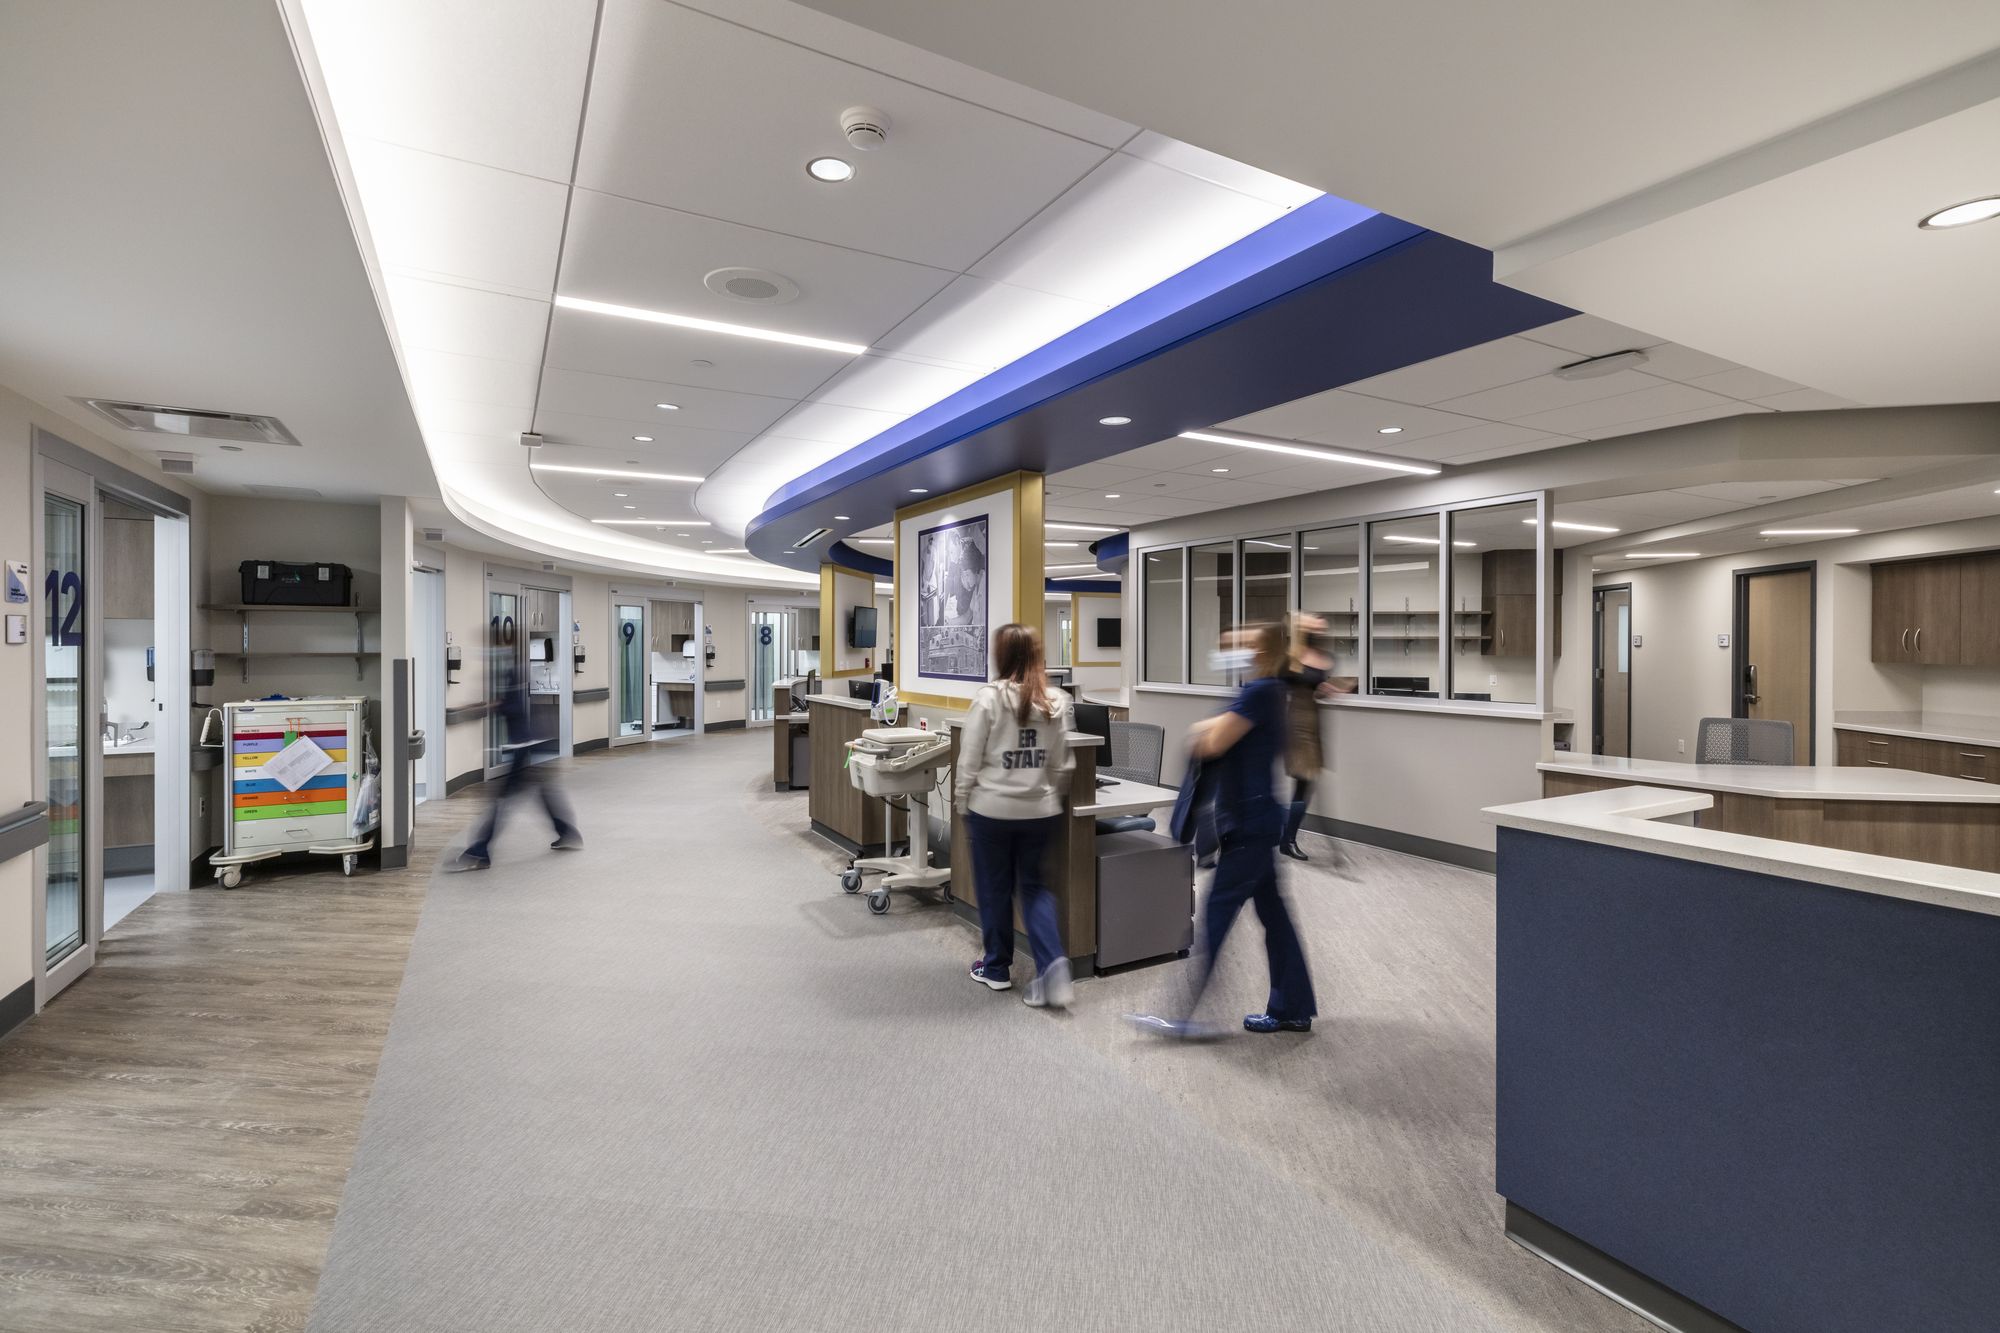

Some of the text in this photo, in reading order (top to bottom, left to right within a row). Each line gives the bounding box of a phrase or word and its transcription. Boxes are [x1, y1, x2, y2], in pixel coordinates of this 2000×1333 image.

[45, 570, 81, 646] 12
[491, 615, 514, 646] 10
[623, 622, 635, 645] 9
[760, 626, 772, 645] 8
[1018, 728, 1037, 748] ER
